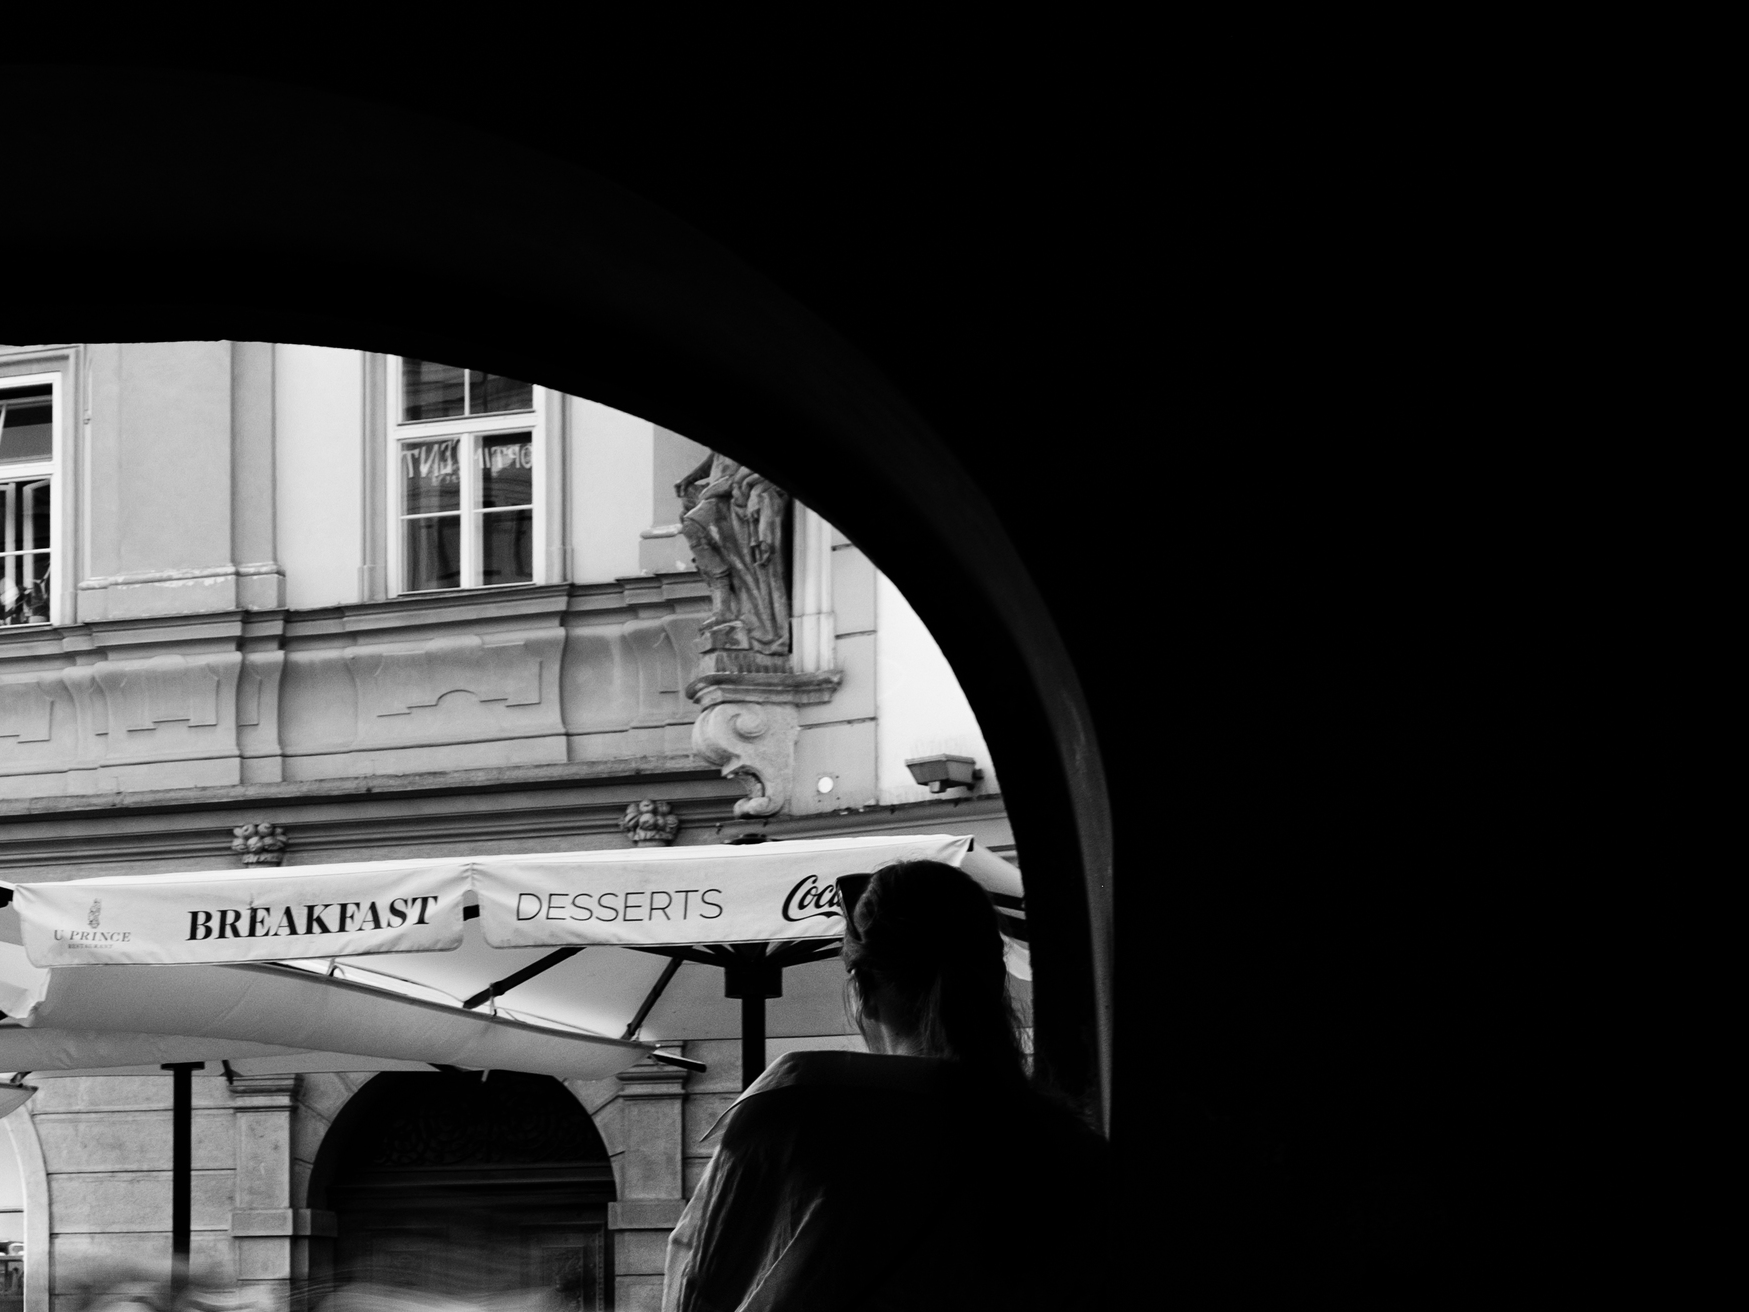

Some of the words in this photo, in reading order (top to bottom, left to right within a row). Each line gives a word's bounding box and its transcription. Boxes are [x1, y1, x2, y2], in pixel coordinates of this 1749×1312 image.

[186, 895, 438, 941] BREAKFAST
[516, 888, 724, 922] DESSERTS
[69, 930, 131, 942] PRINCE
